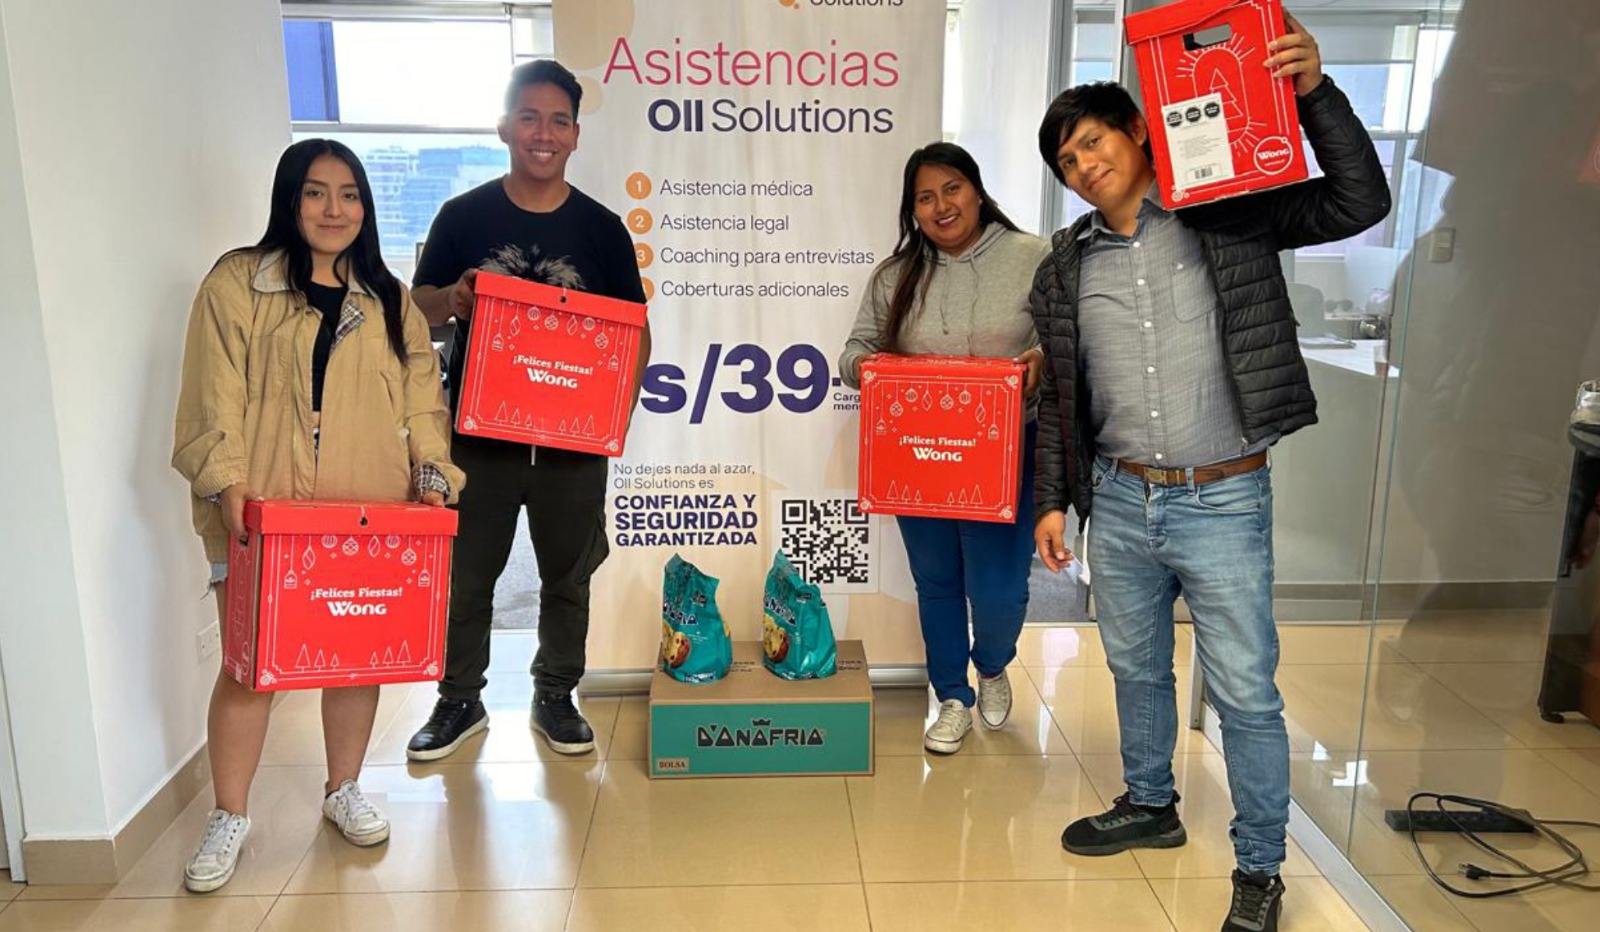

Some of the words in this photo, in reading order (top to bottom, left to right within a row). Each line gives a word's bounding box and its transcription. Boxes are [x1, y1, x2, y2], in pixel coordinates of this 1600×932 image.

[603, 37, 899, 87] Asistencias
[711, 99, 894, 133] Solutions
[636, 181, 642, 192] 1
[660, 179, 746, 196] Asistencia
[751, 178, 813, 197] médica
[635, 215, 645, 228] 2
[660, 214, 746, 231] Asistencia
[751, 214, 789, 234] legal
[636, 249, 646, 262] 3
[660, 247, 739, 267] Coaching
[744, 251, 781, 267] para
[785, 248, 875, 265] entrevistas
[661, 281, 754, 297] Coberturas
[758, 281, 850, 297] adicionales
[513, 354, 552, 369] ¡Felices
[554, 360, 593, 375] Fiestas!
[899, 435, 935, 446] ¡Felices
[938, 436, 976, 447] Fiestas!
[614, 463, 633, 474] No
[635, 463, 671, 476] dejes
[674, 463, 706, 474] nada
[709, 463, 721, 474] al
[724, 465, 755, 475] azar,
[634, 477, 695, 489] Solutions
[698, 480, 714, 489] es
[614, 494, 737, 510] CONFIANZA
[743, 494, 757, 509] Y
[615, 511, 758, 531] SEGURIDAD
[615, 531, 757, 547] GARANTIZADA
[310, 587, 355, 601] ¡Felices
[358, 587, 403, 597] Fiestas!
[658, 760, 686, 769] BOLSA
